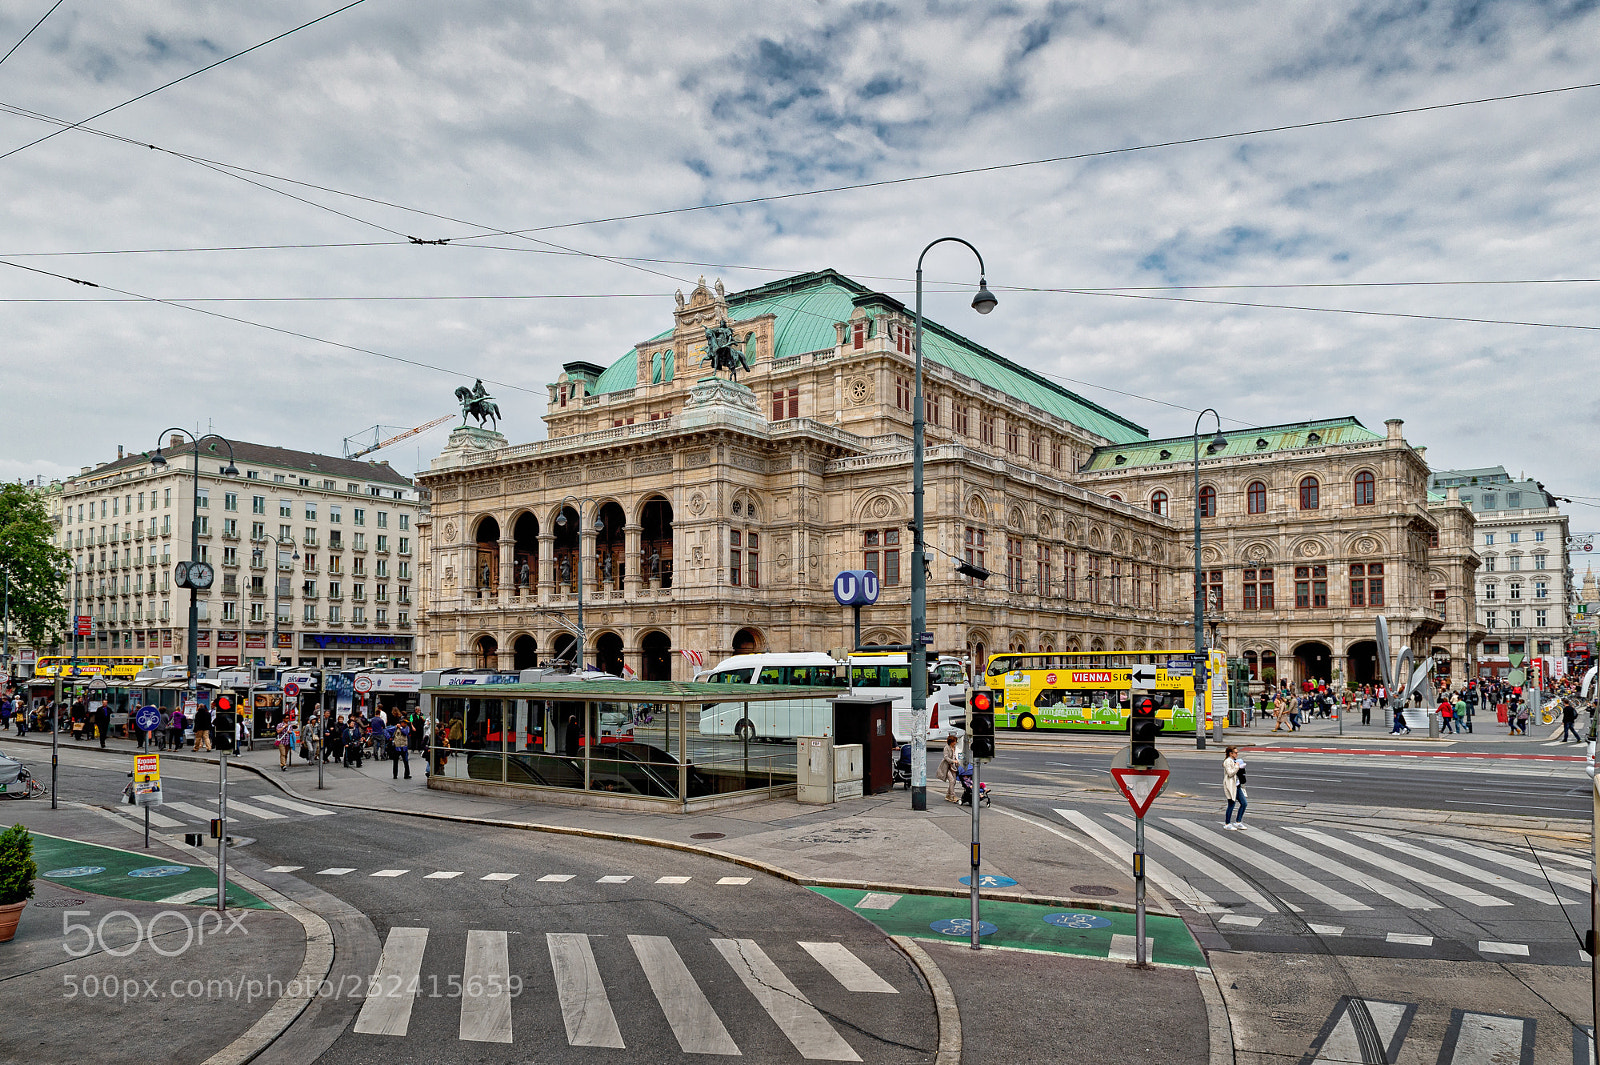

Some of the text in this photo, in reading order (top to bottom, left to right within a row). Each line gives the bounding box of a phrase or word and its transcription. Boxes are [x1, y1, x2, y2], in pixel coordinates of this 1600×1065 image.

[837, 577, 856, 601] U
[864, 576, 878, 600] U
[336, 635, 396, 645] VOLKSBANK
[1073, 673, 1110, 682] VIENNA
